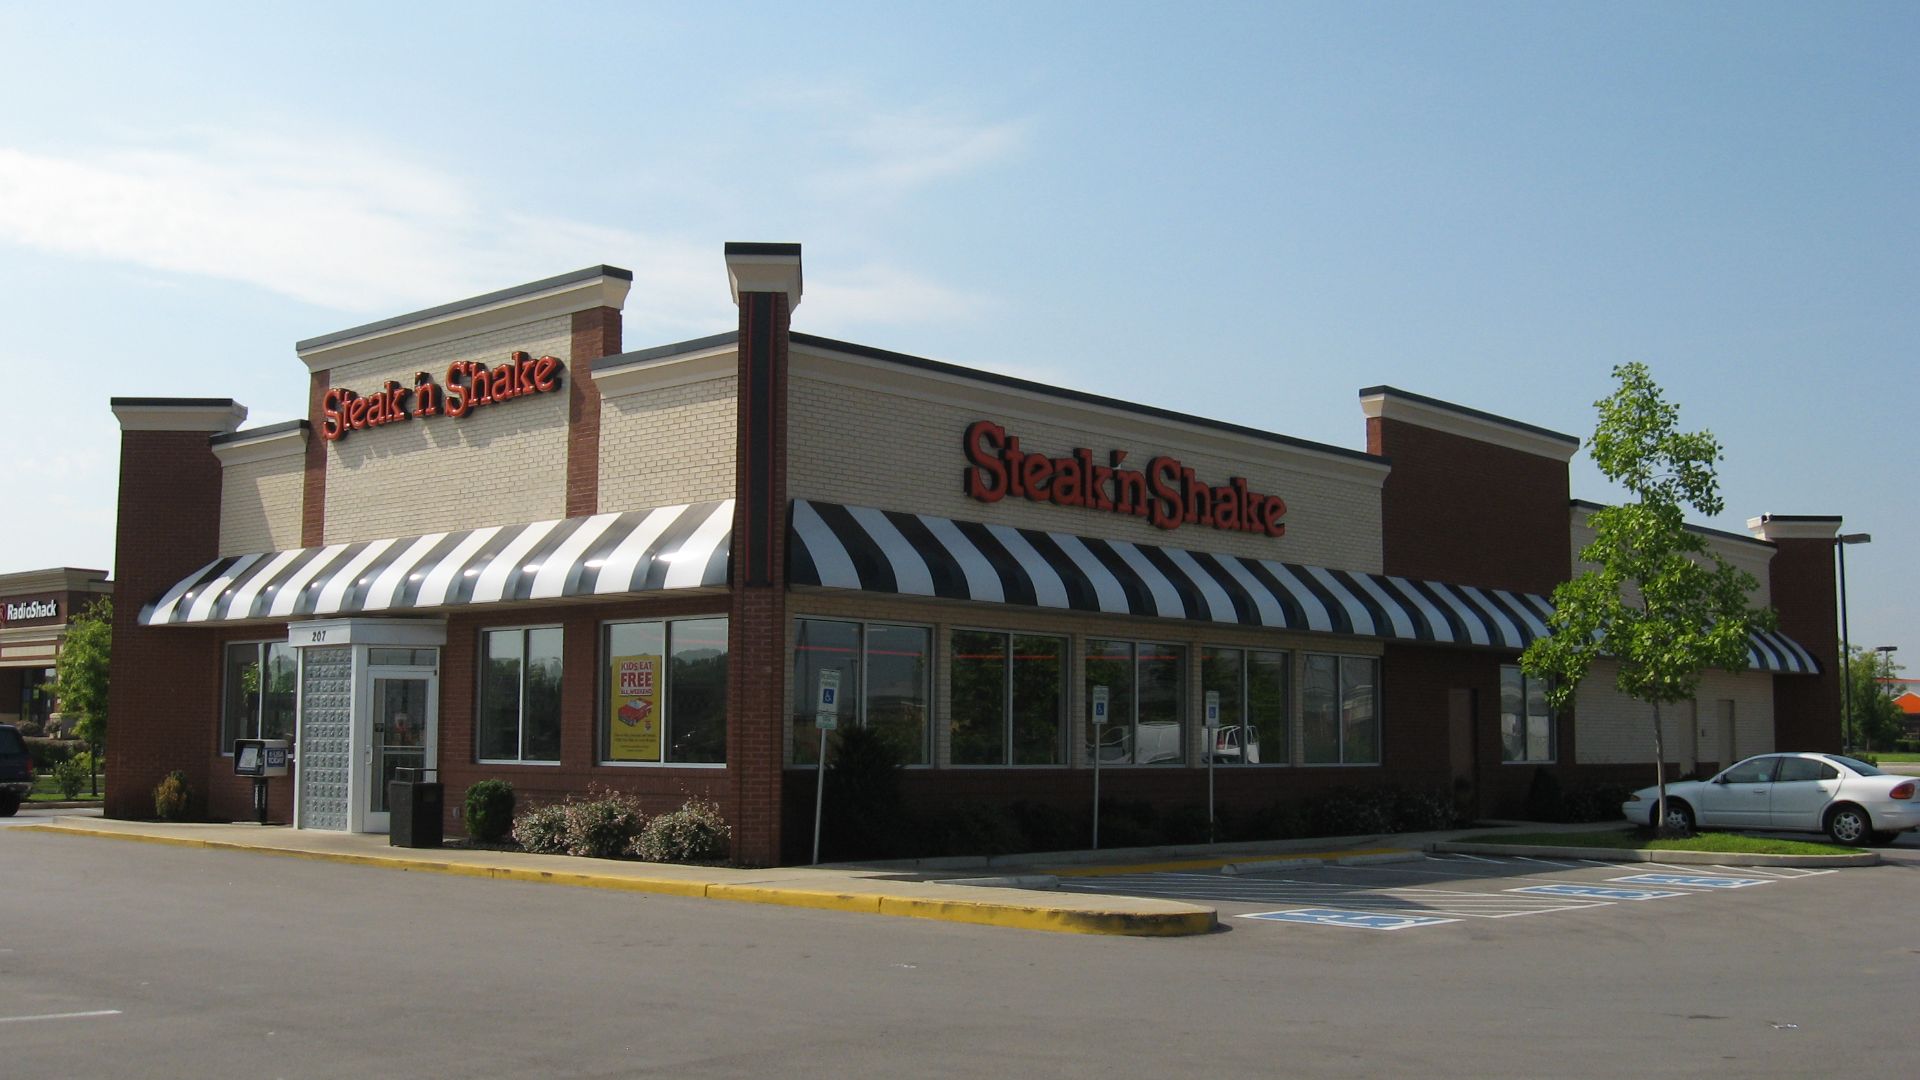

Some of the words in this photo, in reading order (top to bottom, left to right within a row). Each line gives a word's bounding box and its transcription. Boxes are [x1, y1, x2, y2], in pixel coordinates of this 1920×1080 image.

[322, 380, 409, 441] Steak
[445, 351, 560, 418] Shake
[964, 420, 1115, 512] Steak
[1147, 456, 1287, 538] Shake
[7, 599, 57, 620] RadioShack
[312, 630, 326, 642] 207
[621, 661, 638, 670] KIDS
[639, 661, 653, 670] EAT
[620, 671, 653, 687] FREE
